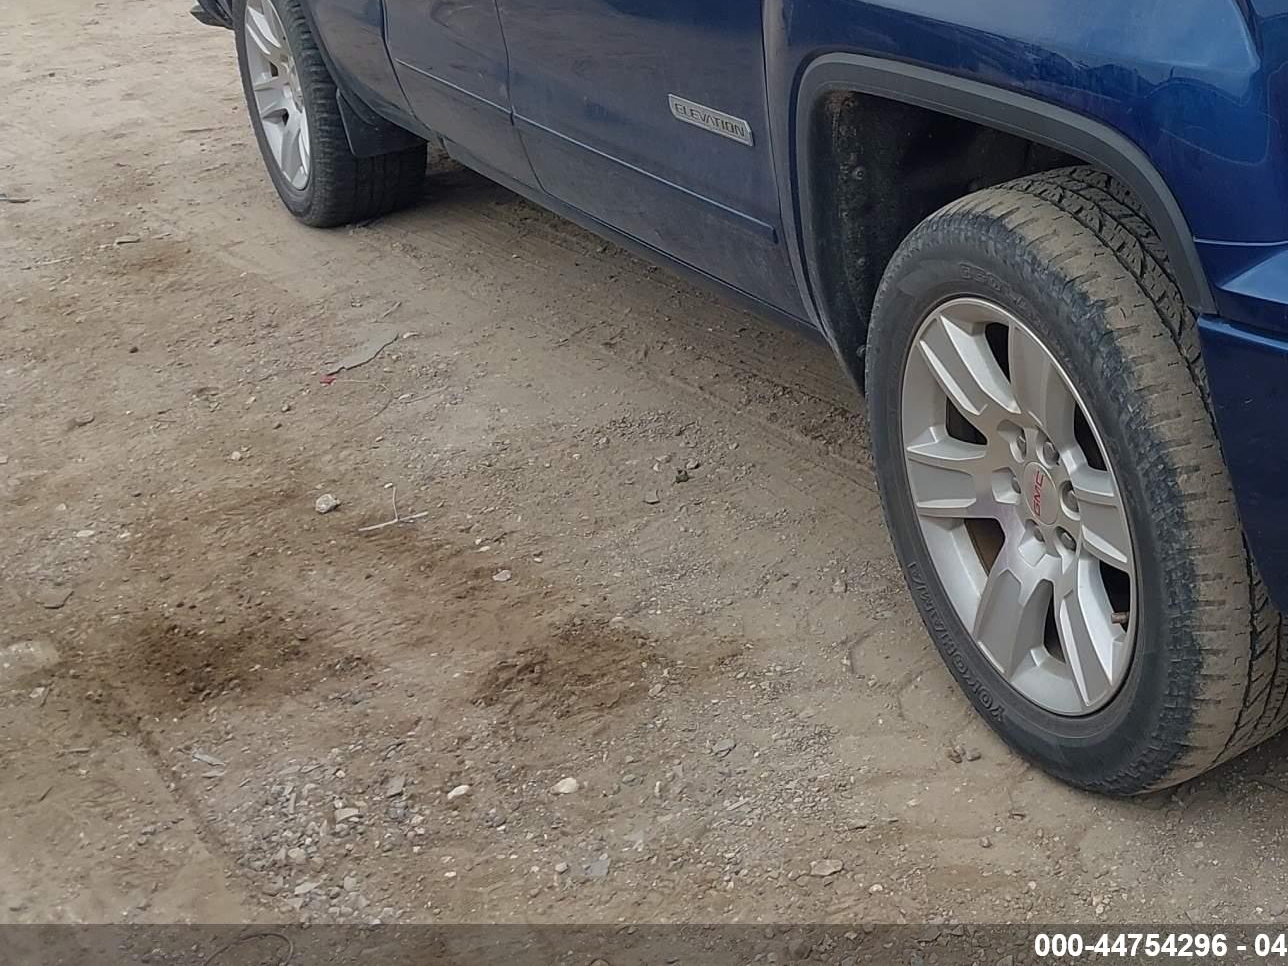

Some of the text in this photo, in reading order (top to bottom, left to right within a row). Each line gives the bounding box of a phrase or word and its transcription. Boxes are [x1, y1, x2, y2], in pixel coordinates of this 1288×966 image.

[674, 103, 745, 137] ELEVATION
[1033, 470, 1044, 516] GMC
[906, 561, 1006, 722] YOKOHAMA
